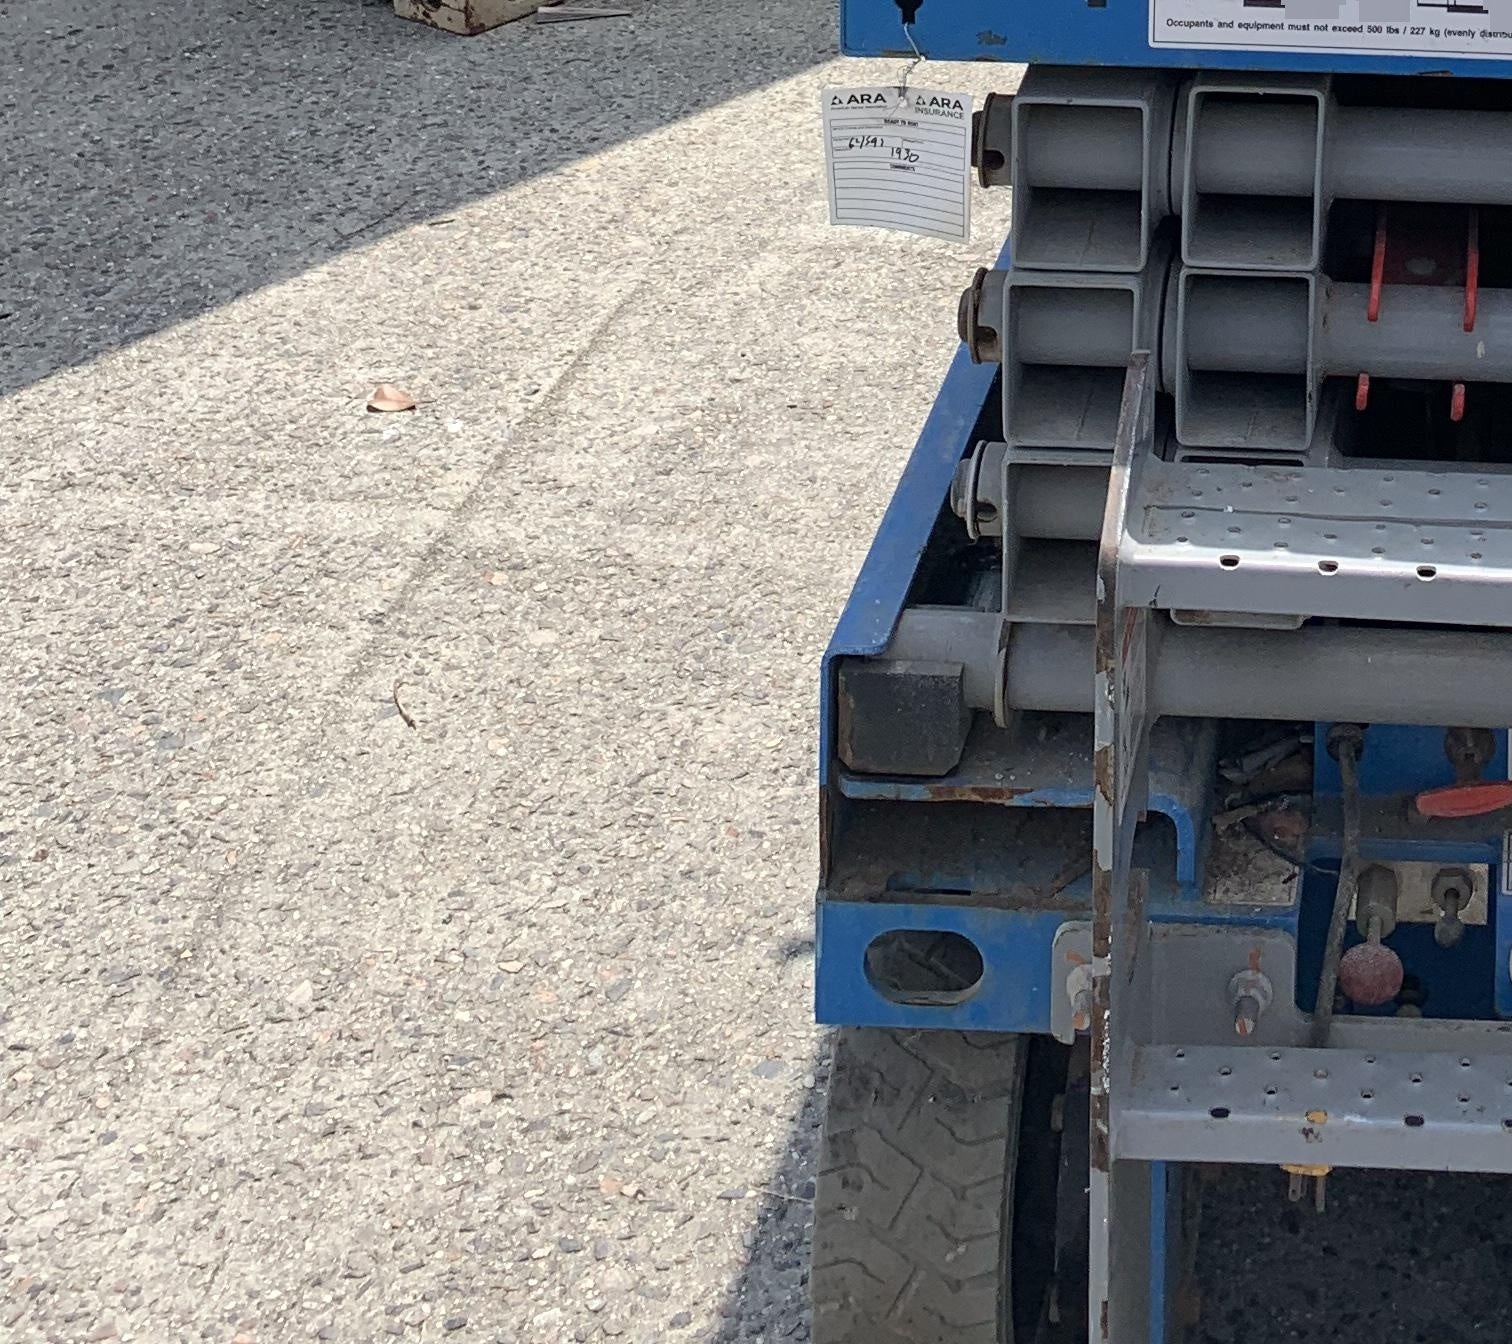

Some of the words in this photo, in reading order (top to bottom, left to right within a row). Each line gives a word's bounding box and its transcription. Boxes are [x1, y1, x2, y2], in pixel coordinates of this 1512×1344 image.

[1166, 18, 1214, 29] Occupants
[1217, 20, 1234, 28] and
[1238, 21, 1284, 31] equipment
[1288, 23, 1310, 31] must
[1332, 24, 1363, 33] exceed
[1367, 26, 1382, 34] 500
[1387, 26, 1399, 34] lbs
[1410, 27, 1425, 35] 227
[1429, 27, 1440, 37] kg
[1444, 28, 1475, 38] (evenly
[846, 93, 887, 104] ARA
[929, 96, 964, 111] ARA
[914, 107, 965, 120] INSURANCE
[891, 147, 919, 162] 1930
